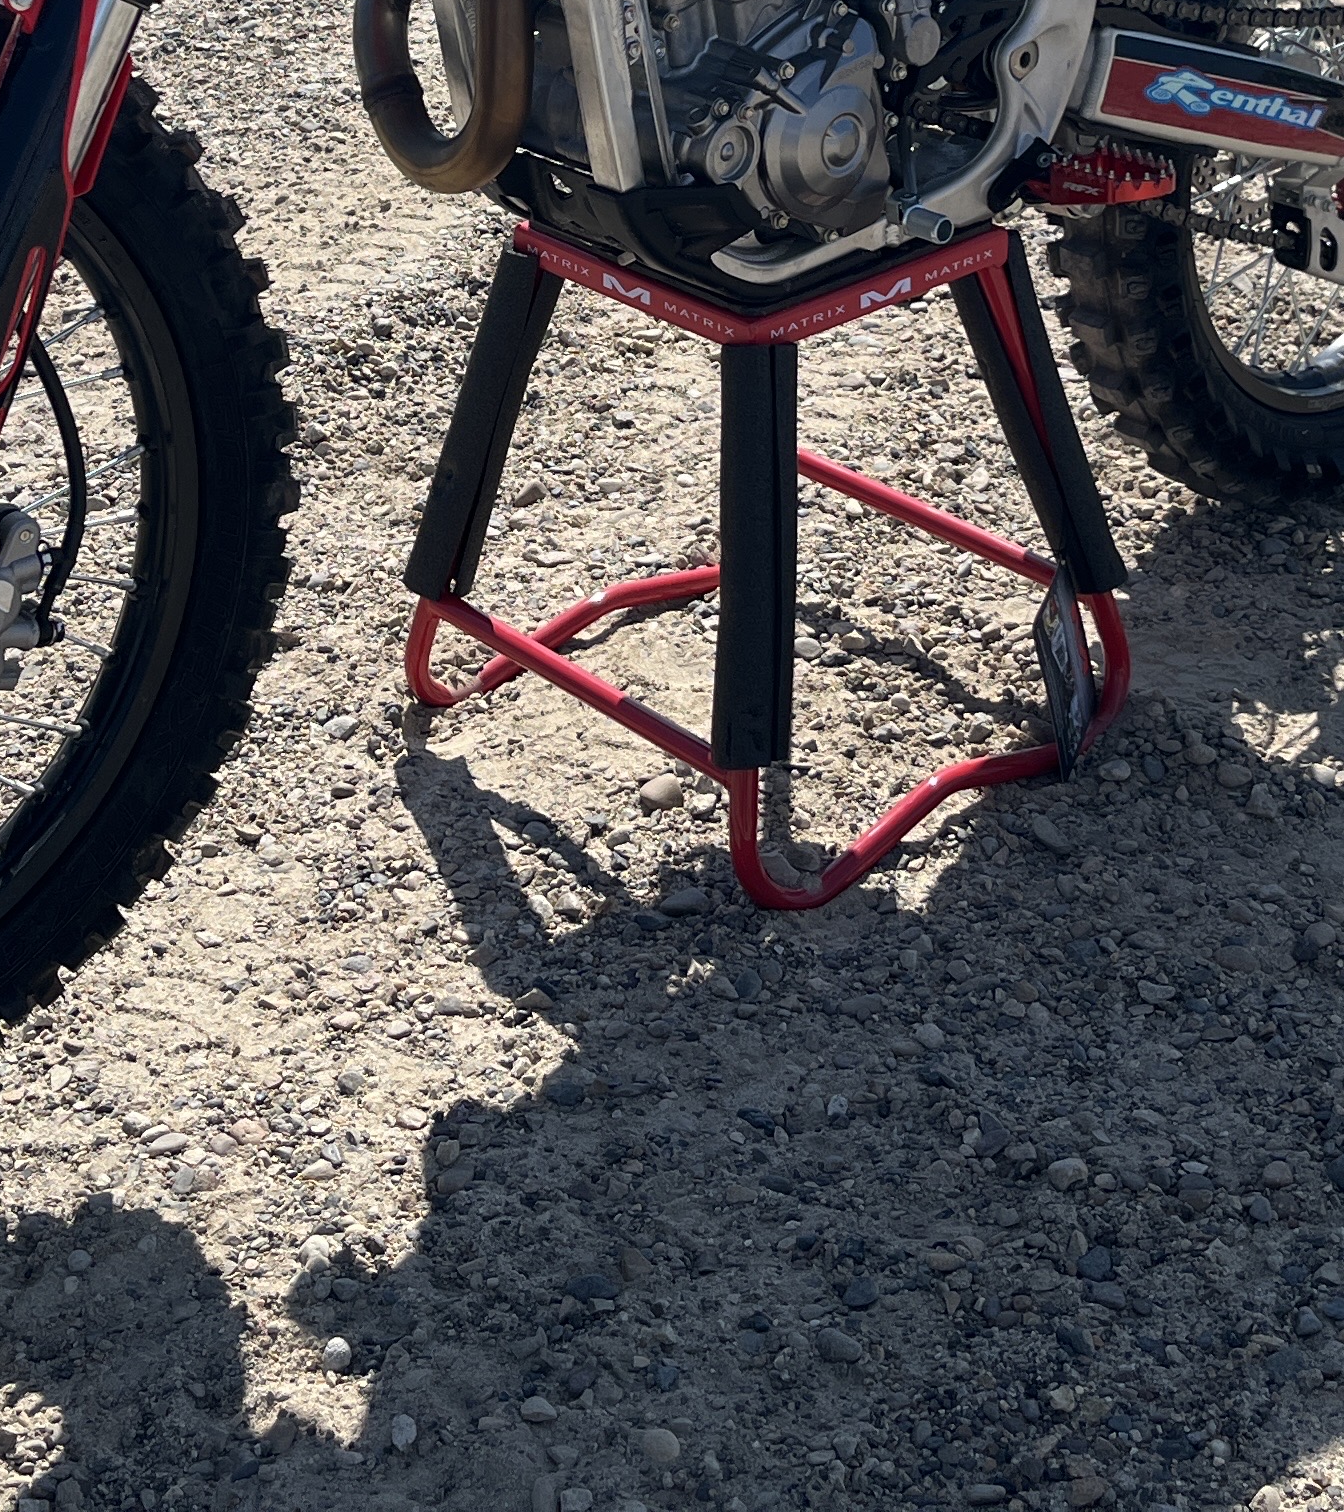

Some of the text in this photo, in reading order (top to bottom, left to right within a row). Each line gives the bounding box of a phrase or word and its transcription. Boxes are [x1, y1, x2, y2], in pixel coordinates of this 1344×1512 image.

[1145, 66, 1326, 129] Renthal
[526, 244, 590, 277] MATRIX
[663, 302, 735, 338] MATRIX
[769, 304, 846, 339] MATRIX
[924, 248, 993, 282] MATRIX
